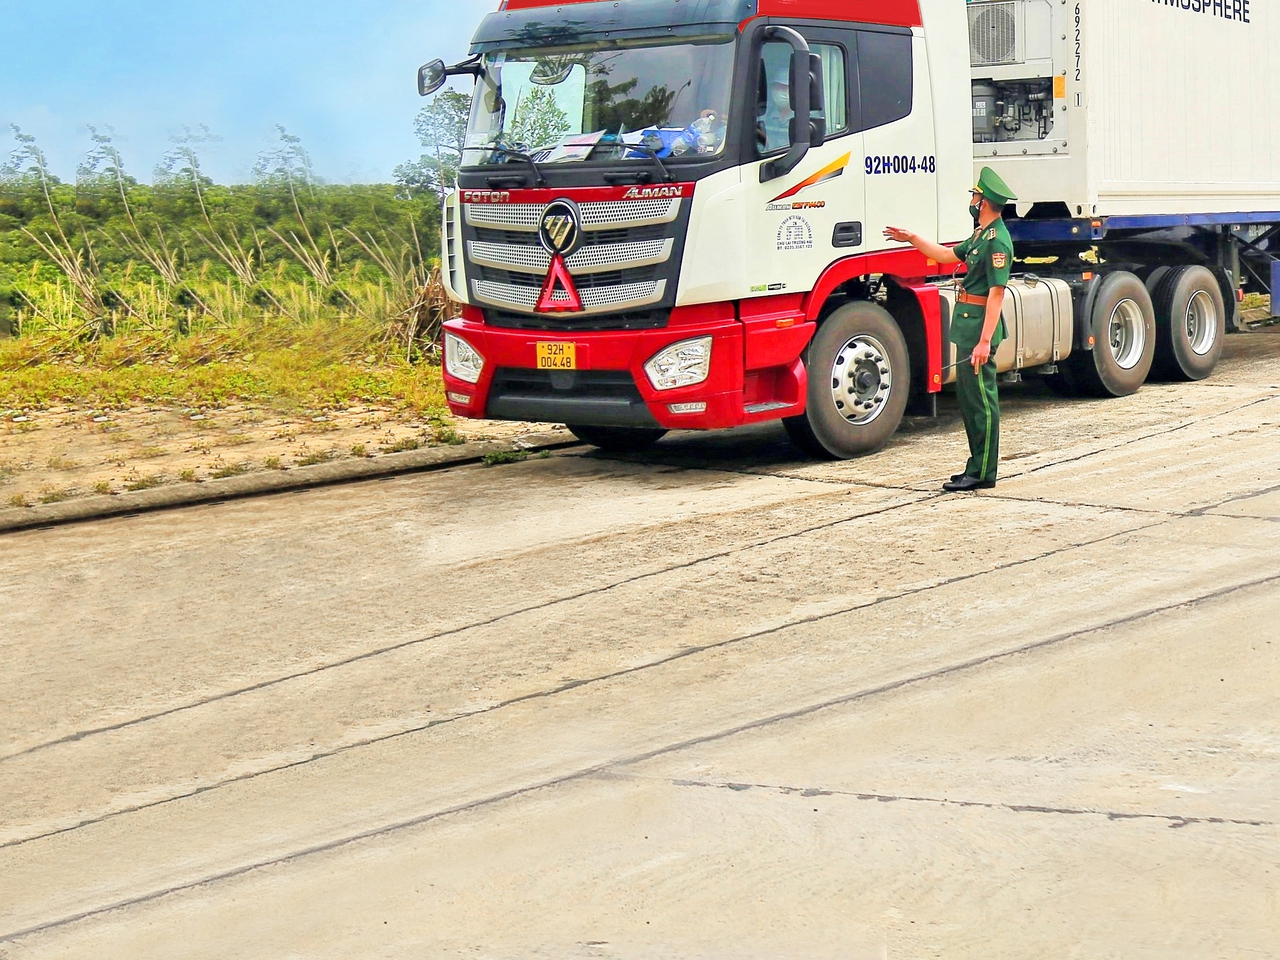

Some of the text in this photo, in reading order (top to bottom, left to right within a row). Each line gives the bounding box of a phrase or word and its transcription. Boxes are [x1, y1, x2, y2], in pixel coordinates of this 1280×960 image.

[622, 186, 683, 199] AUMAN
[547, 344, 564, 355] 92H
[541, 356, 572, 368] 004.48
